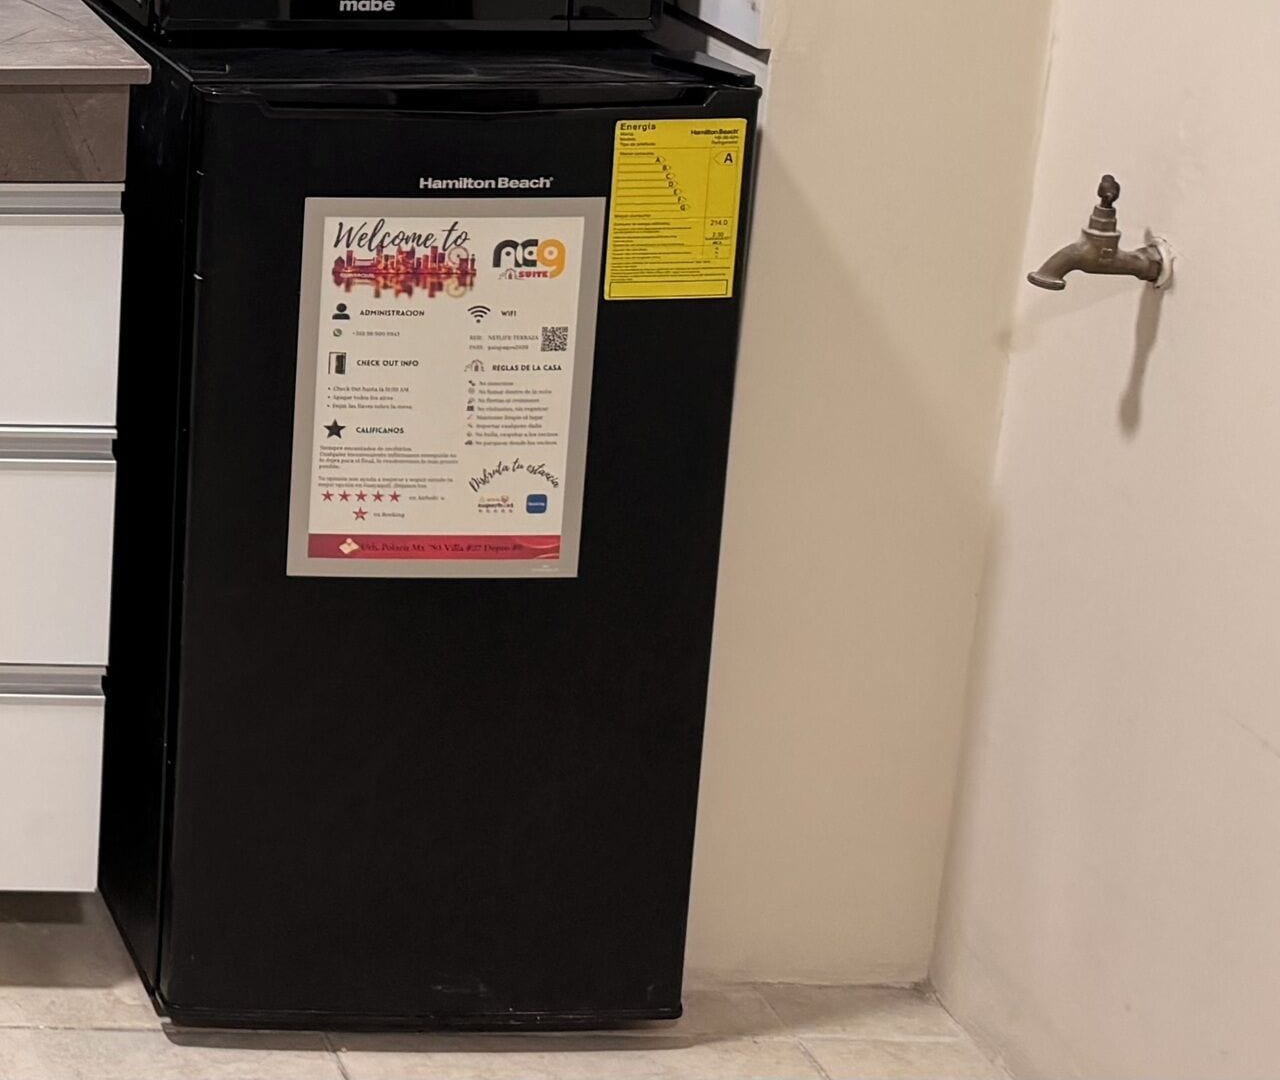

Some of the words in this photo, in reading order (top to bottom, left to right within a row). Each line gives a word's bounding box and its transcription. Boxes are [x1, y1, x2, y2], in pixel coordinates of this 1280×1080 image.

[723, 153, 733, 164] A
[419, 177, 496, 189] Hamilton
[333, 218, 437, 252] Welcome
[441, 220, 470, 252] to
[518, 270, 548, 278] SUITE
[356, 359, 380, 367] CHECK
[382, 359, 399, 367] OUT
[400, 359, 419, 367] INFO
[355, 426, 404, 434] CALIFICANOS
[512, 457, 525, 472] tu
